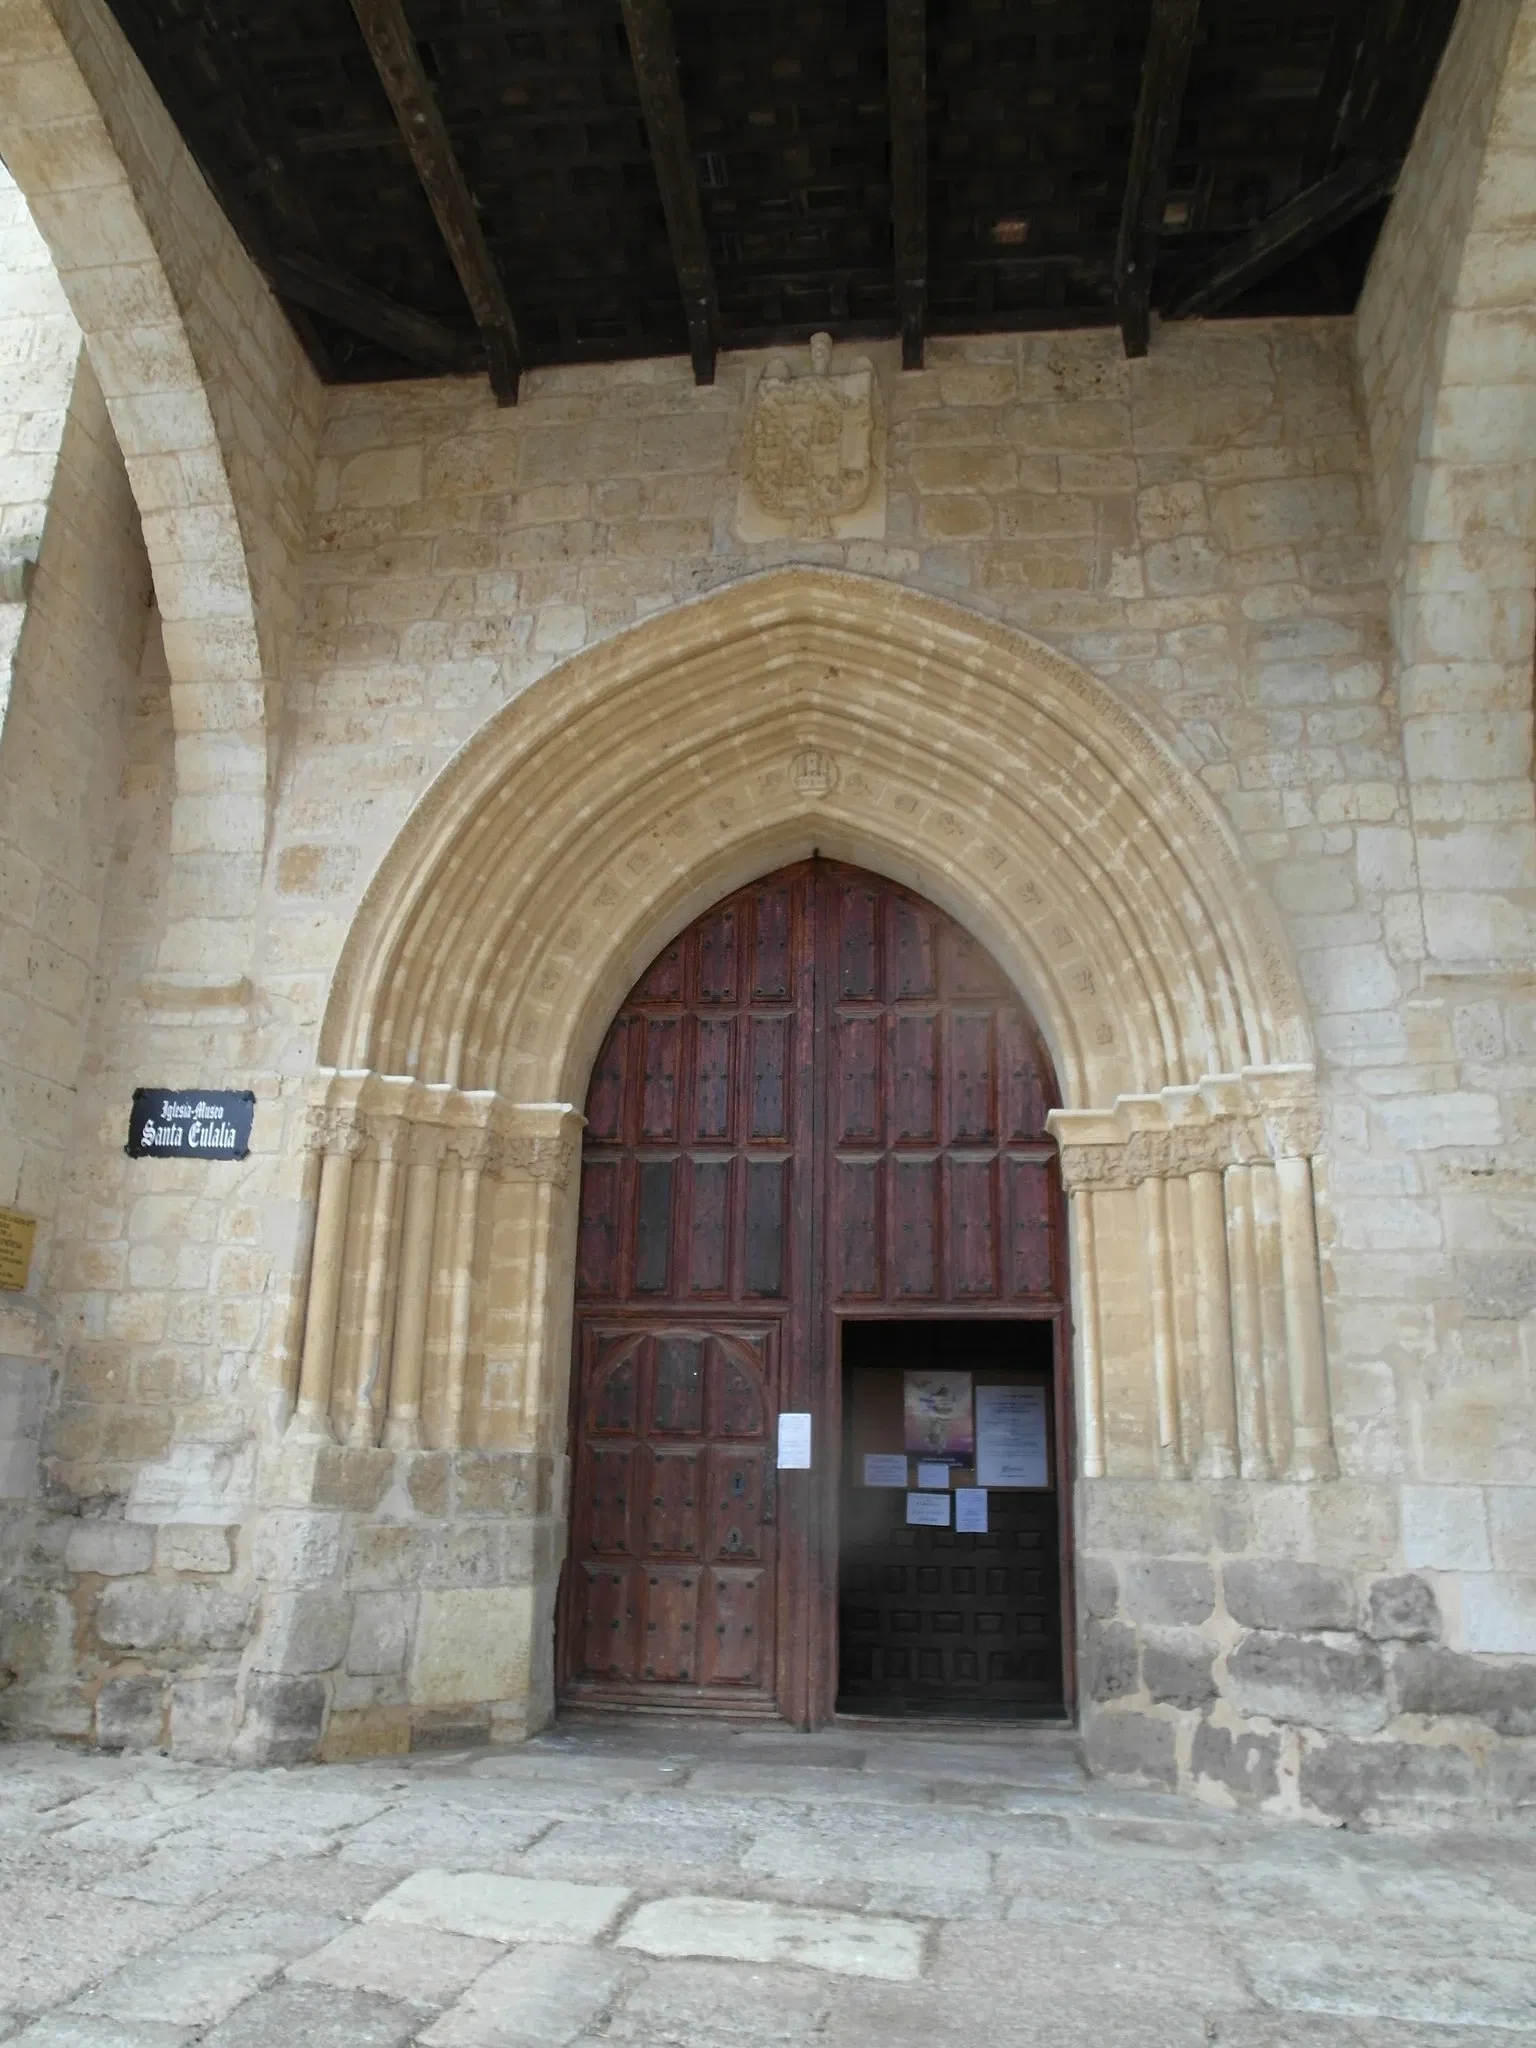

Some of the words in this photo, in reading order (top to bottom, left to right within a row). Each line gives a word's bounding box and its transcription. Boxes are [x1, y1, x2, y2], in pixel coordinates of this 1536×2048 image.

[160, 1100, 224, 1121] Iglesia-Museo
[140, 1119, 183, 1147] Santa
[187, 1121, 236, 1148] Eulalia
